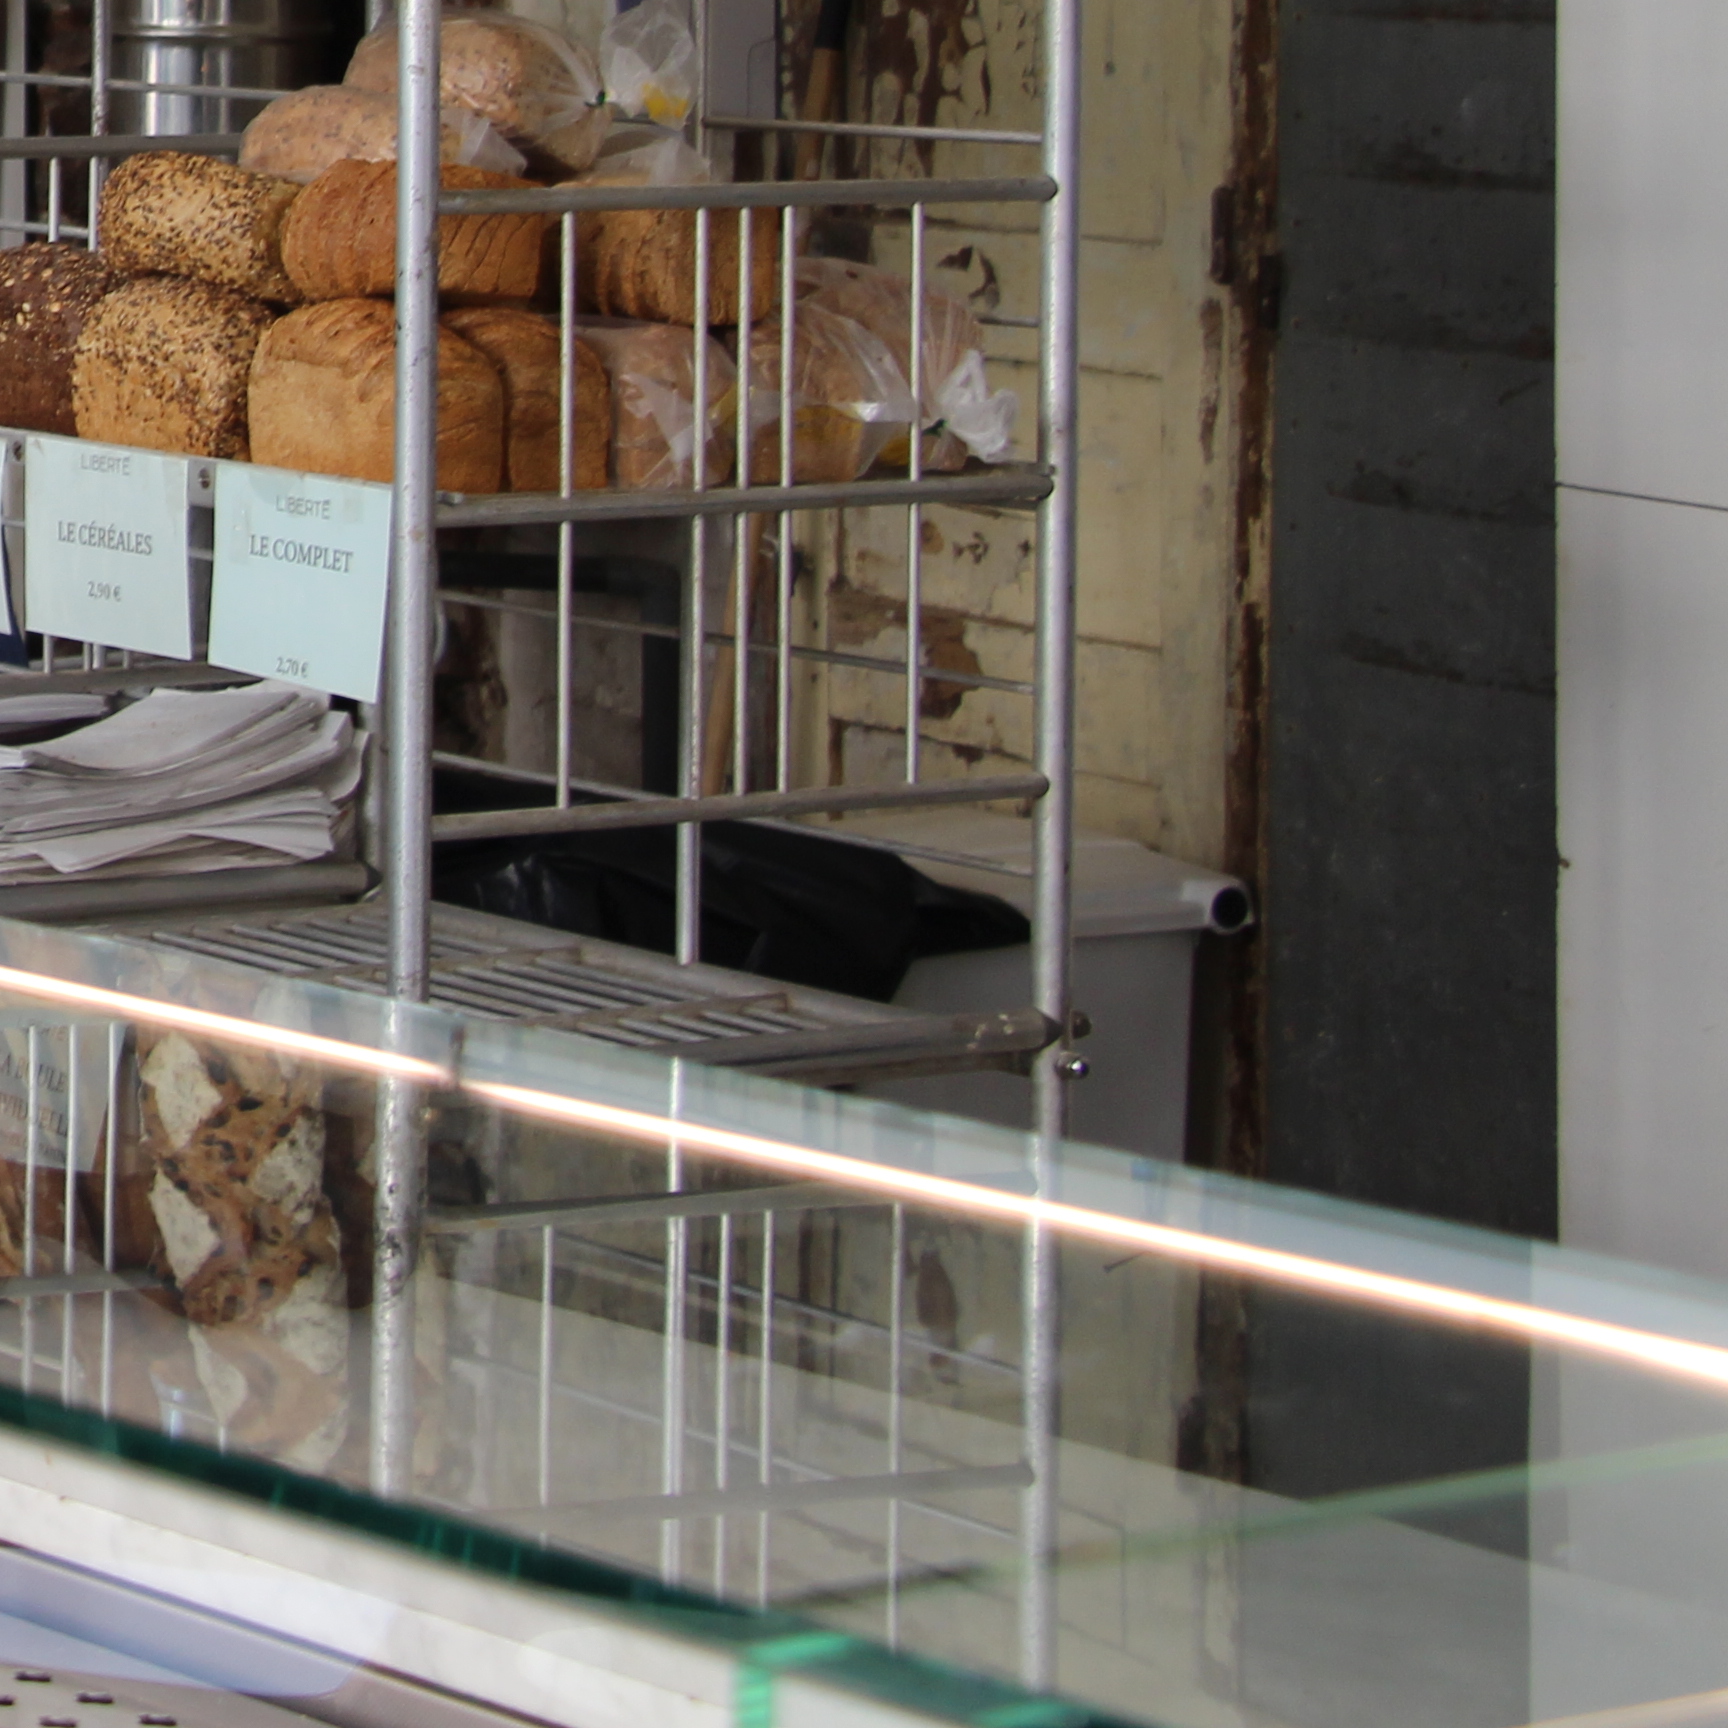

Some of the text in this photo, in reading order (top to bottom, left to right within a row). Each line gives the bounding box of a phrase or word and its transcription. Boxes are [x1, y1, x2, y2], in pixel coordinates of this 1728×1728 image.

[80, 453, 131, 476] LIBERTÉ
[276, 494, 331, 520] LIBERTÉ
[57, 520, 153, 556] LE CÉRÉALES
[249, 534, 354, 574] LE COMPLET
[87, 580, 122, 603] 2,90 €
[275, 656, 310, 679] 2,70 €
